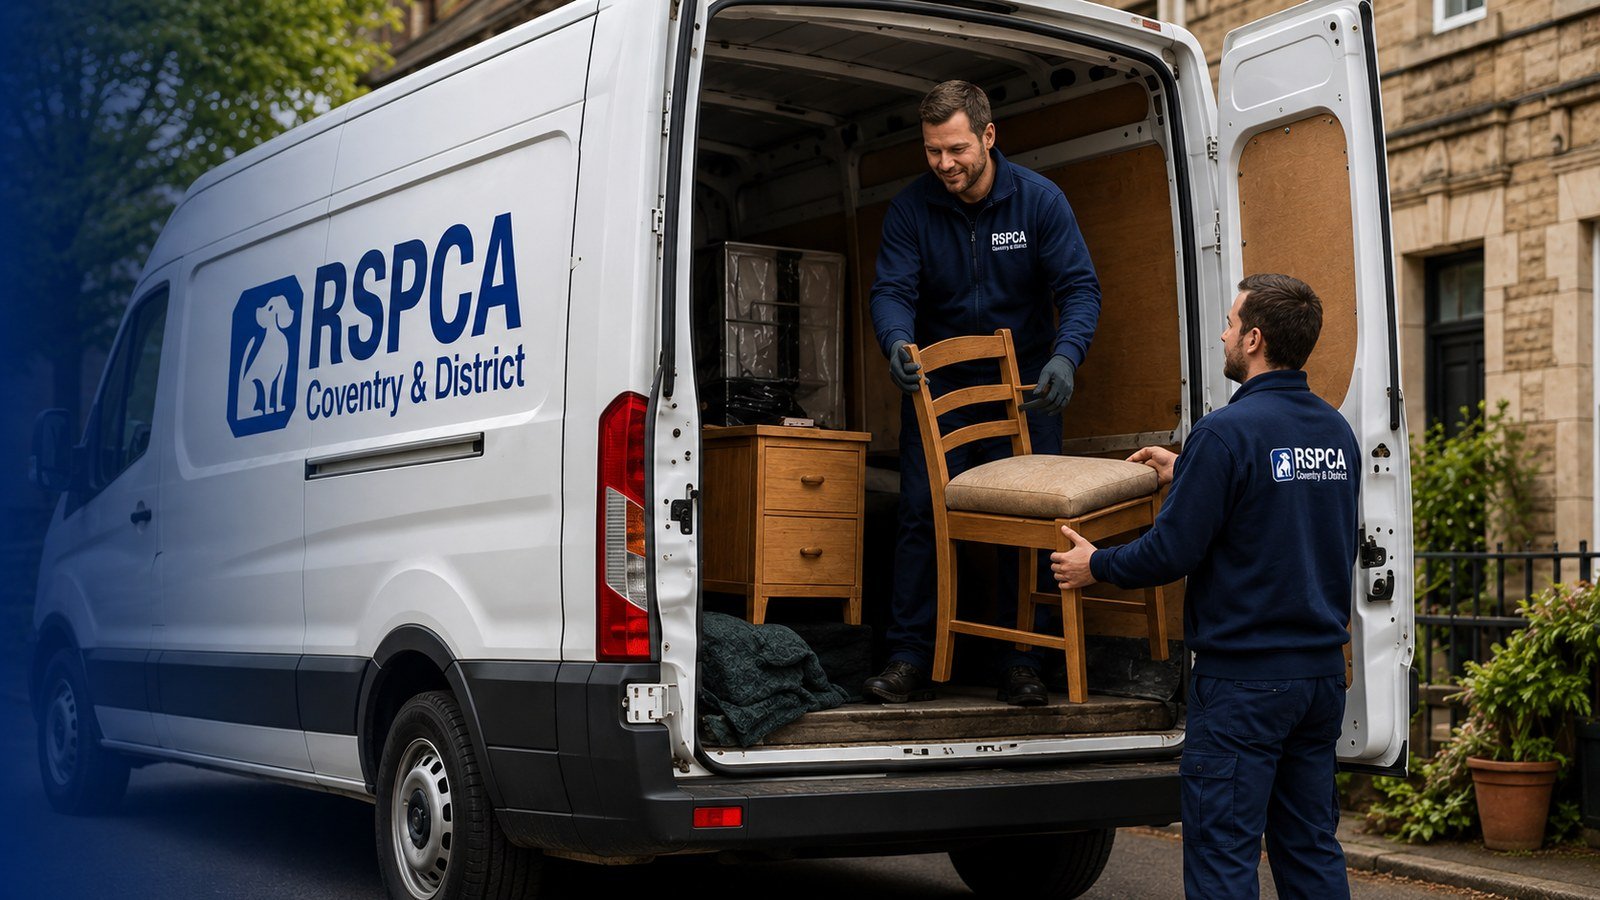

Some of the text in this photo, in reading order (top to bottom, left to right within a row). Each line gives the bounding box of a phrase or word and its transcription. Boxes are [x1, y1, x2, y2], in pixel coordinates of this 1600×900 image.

[991, 230, 1027, 246] RSPCA
[308, 212, 522, 369] RSPCA
[306, 343, 526, 421] Coventry & District
[1294, 447, 1347, 470] RSPCA
